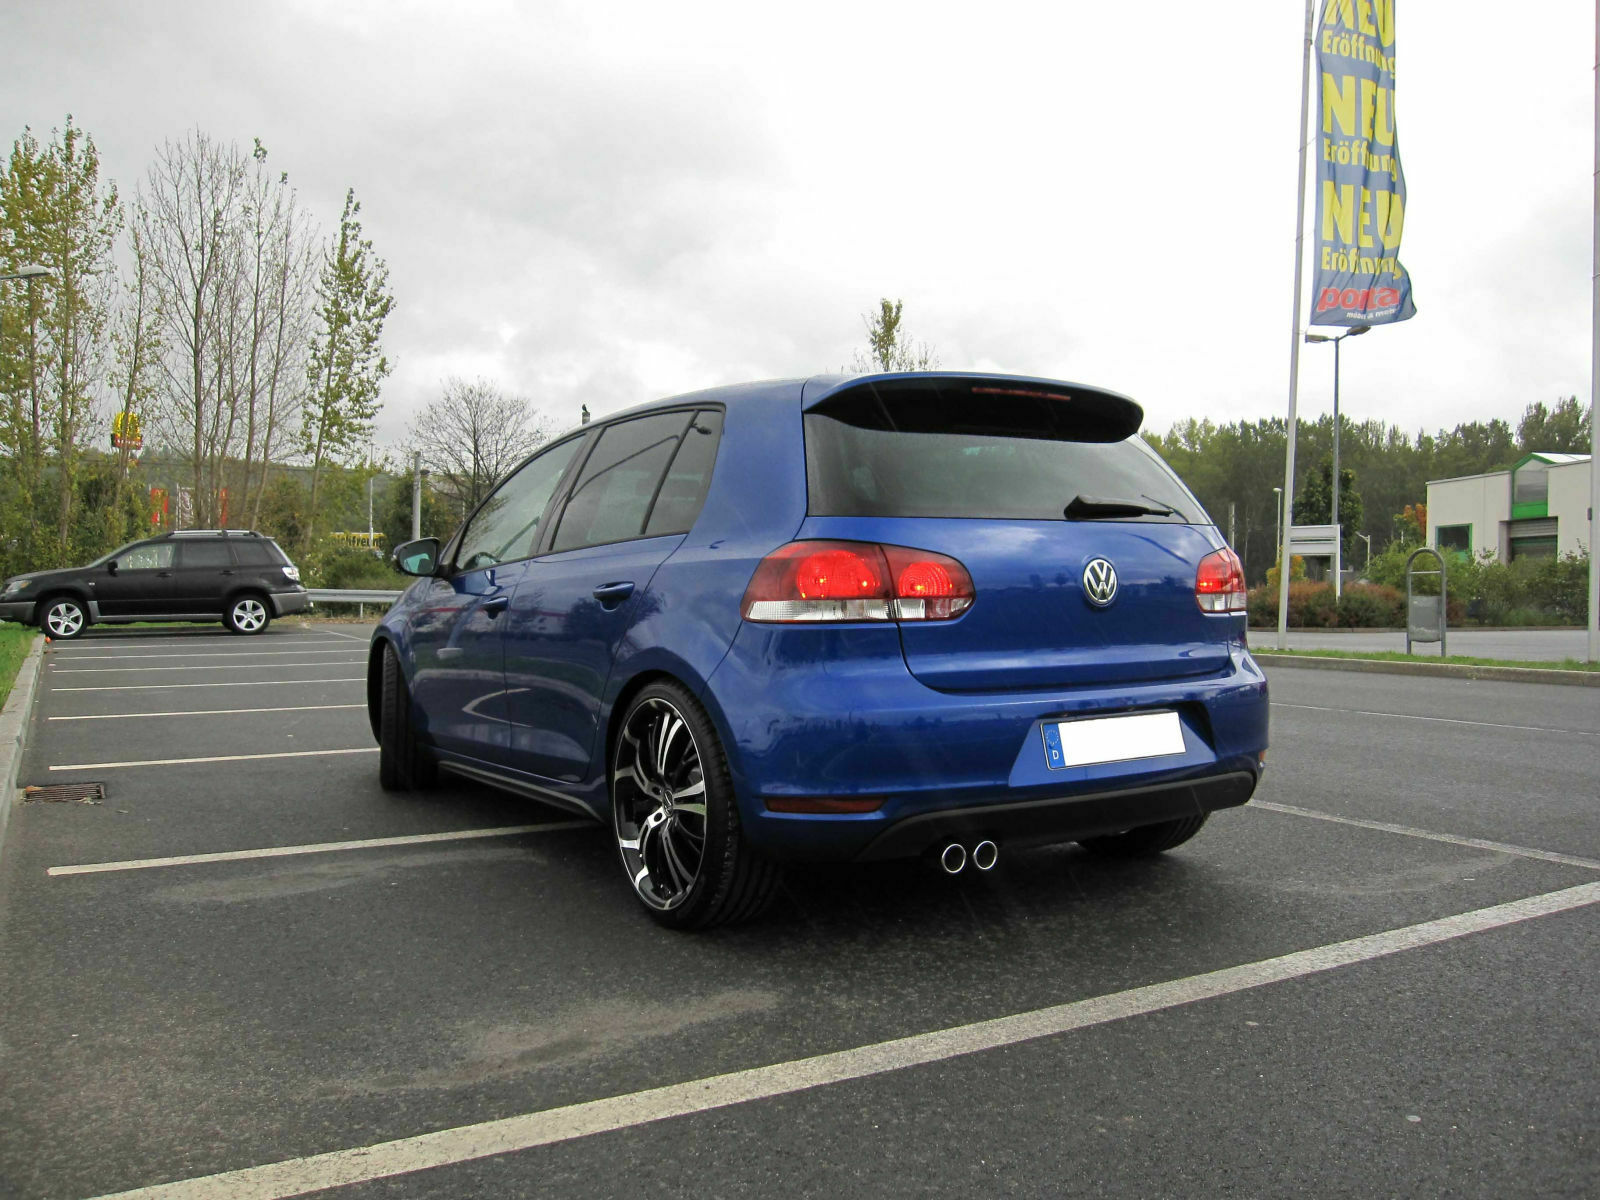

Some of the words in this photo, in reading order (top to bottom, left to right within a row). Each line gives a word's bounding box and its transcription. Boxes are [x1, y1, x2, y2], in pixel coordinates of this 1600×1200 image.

[1322, 72, 1395, 146] NEU
[1322, 180, 1404, 250] NEU
[1052, 750, 1060, 760] D
